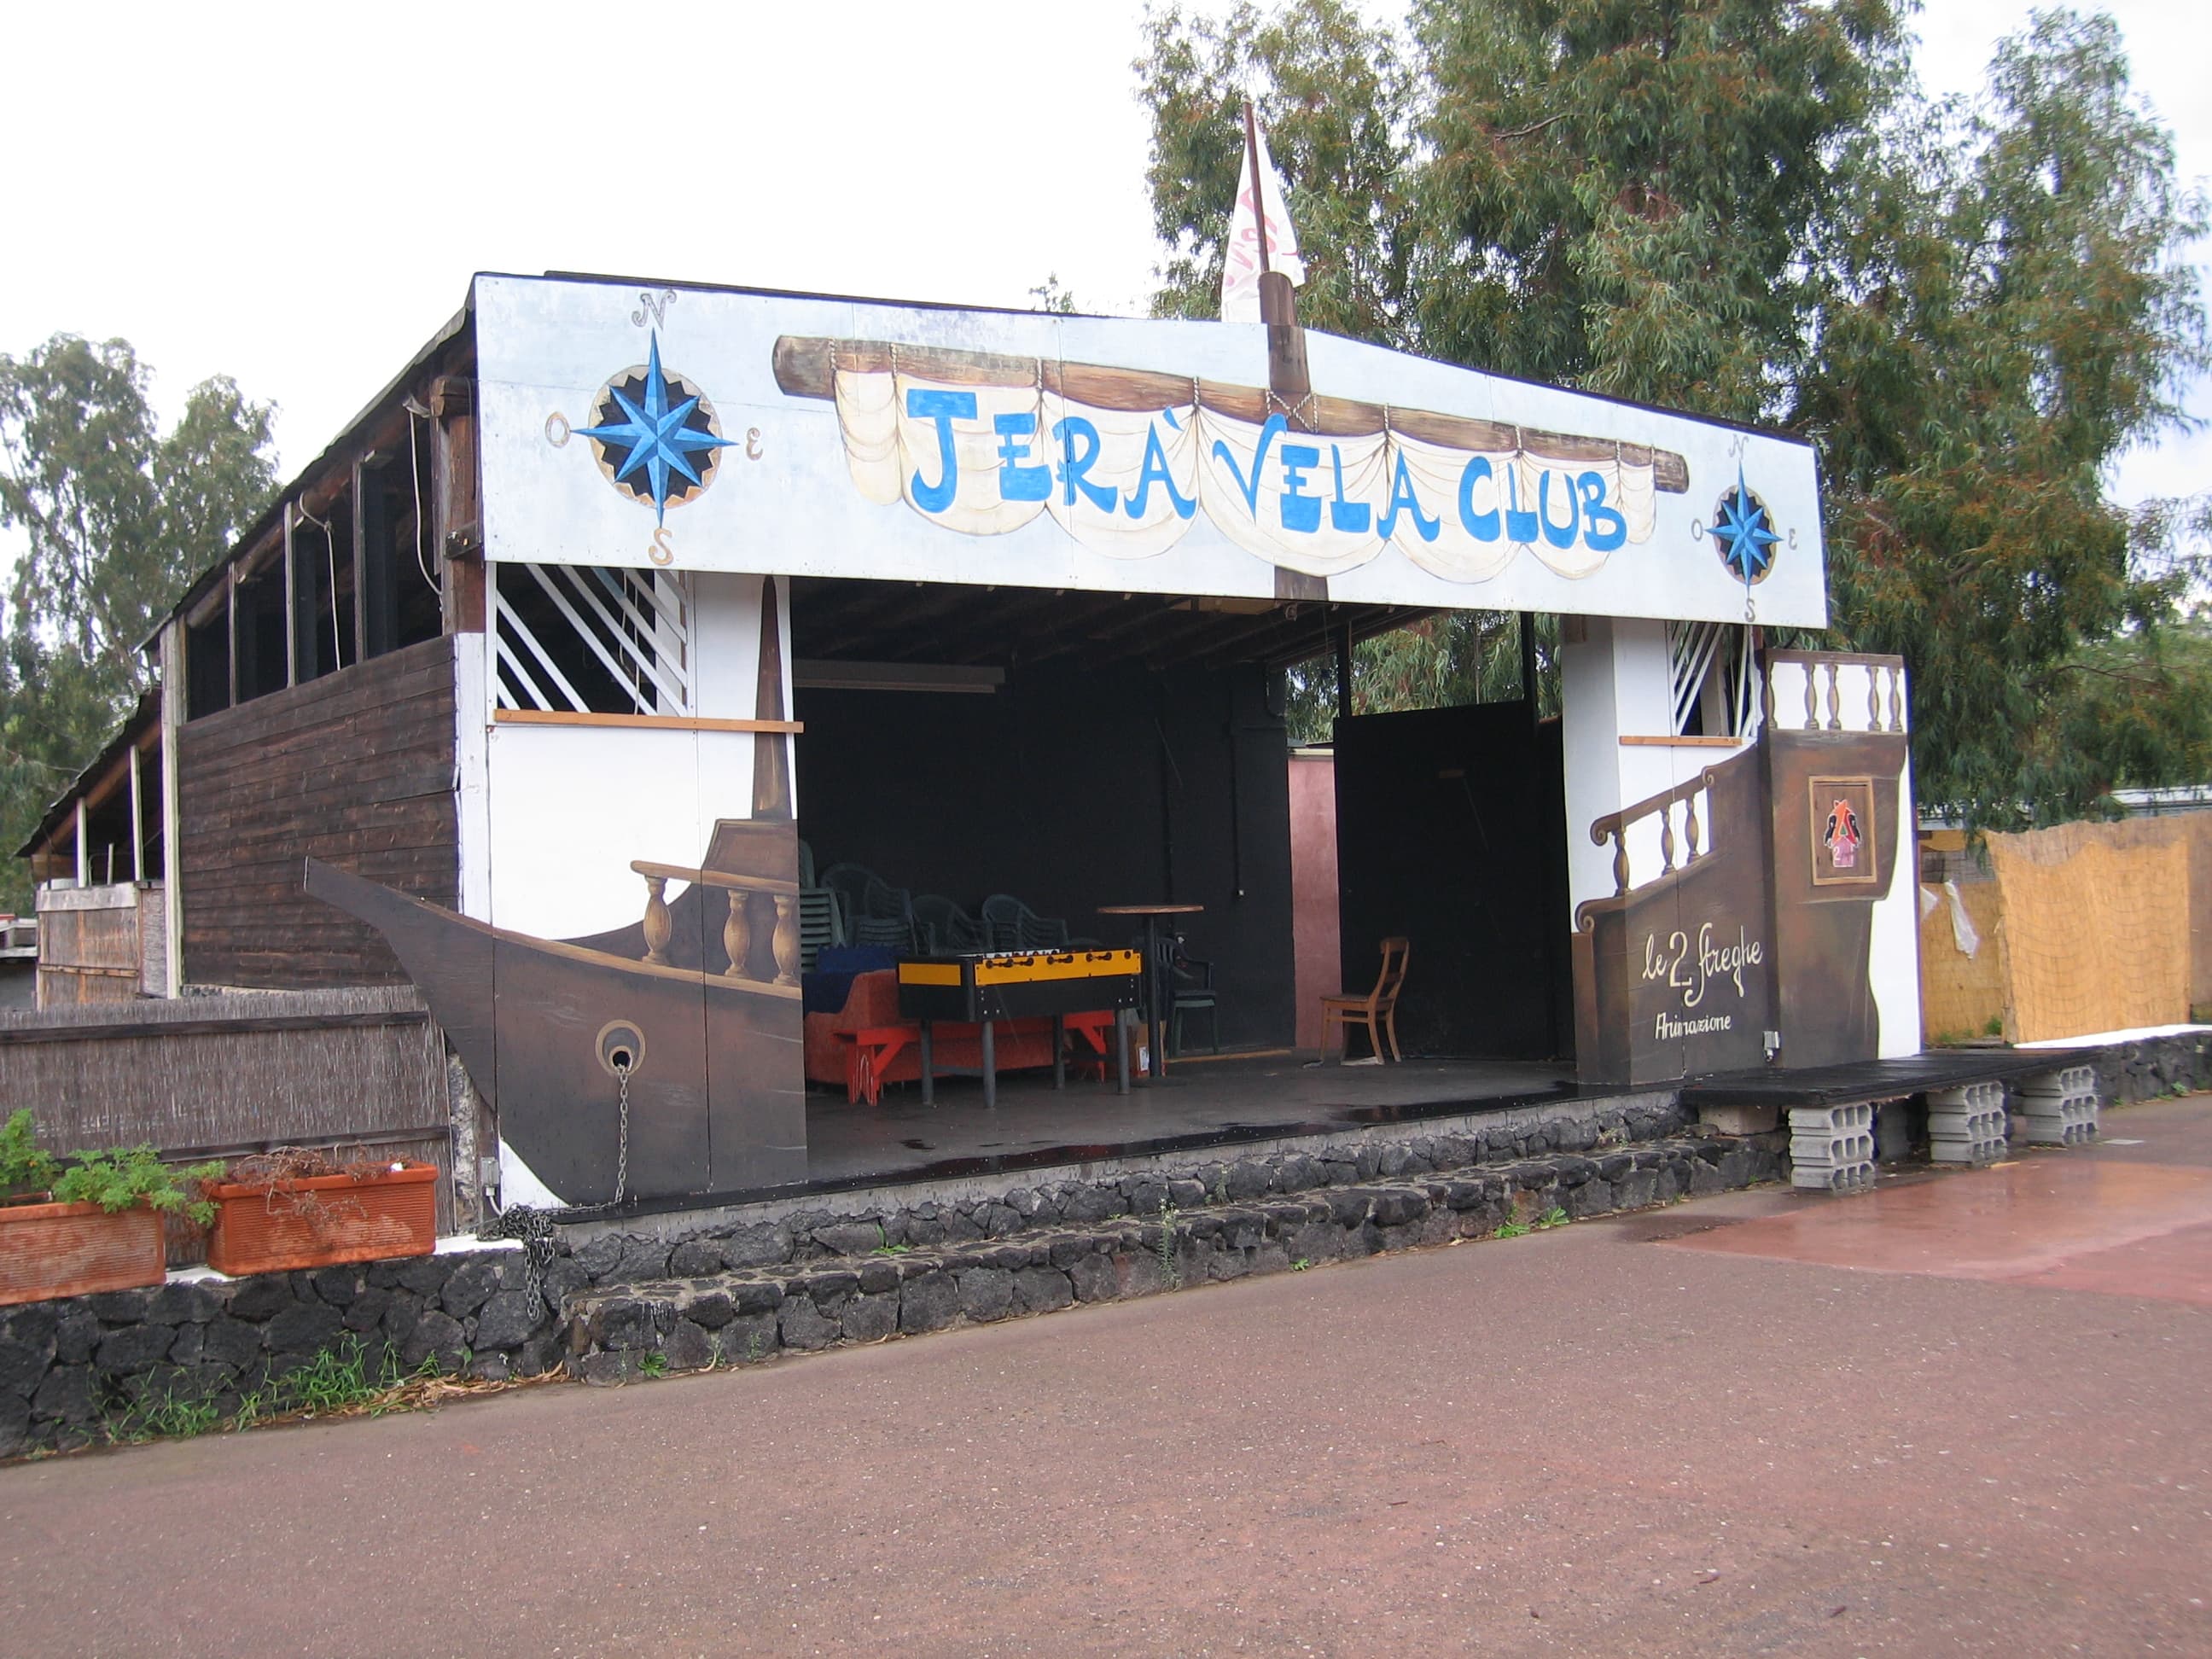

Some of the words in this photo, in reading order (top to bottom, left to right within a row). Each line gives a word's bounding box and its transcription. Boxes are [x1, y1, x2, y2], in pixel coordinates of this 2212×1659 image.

[632, 288, 677, 330] N
[544, 411, 571, 448] O
[1728, 434, 1750, 459] N
[1458, 456, 1627, 551] CLUB
[648, 527, 674, 566] S
[1745, 597, 1756, 623] S
[1642, 933, 1668, 981] le
[1669, 931, 1692, 987] 2
[1654, 1011, 1732, 1040] Animazione
